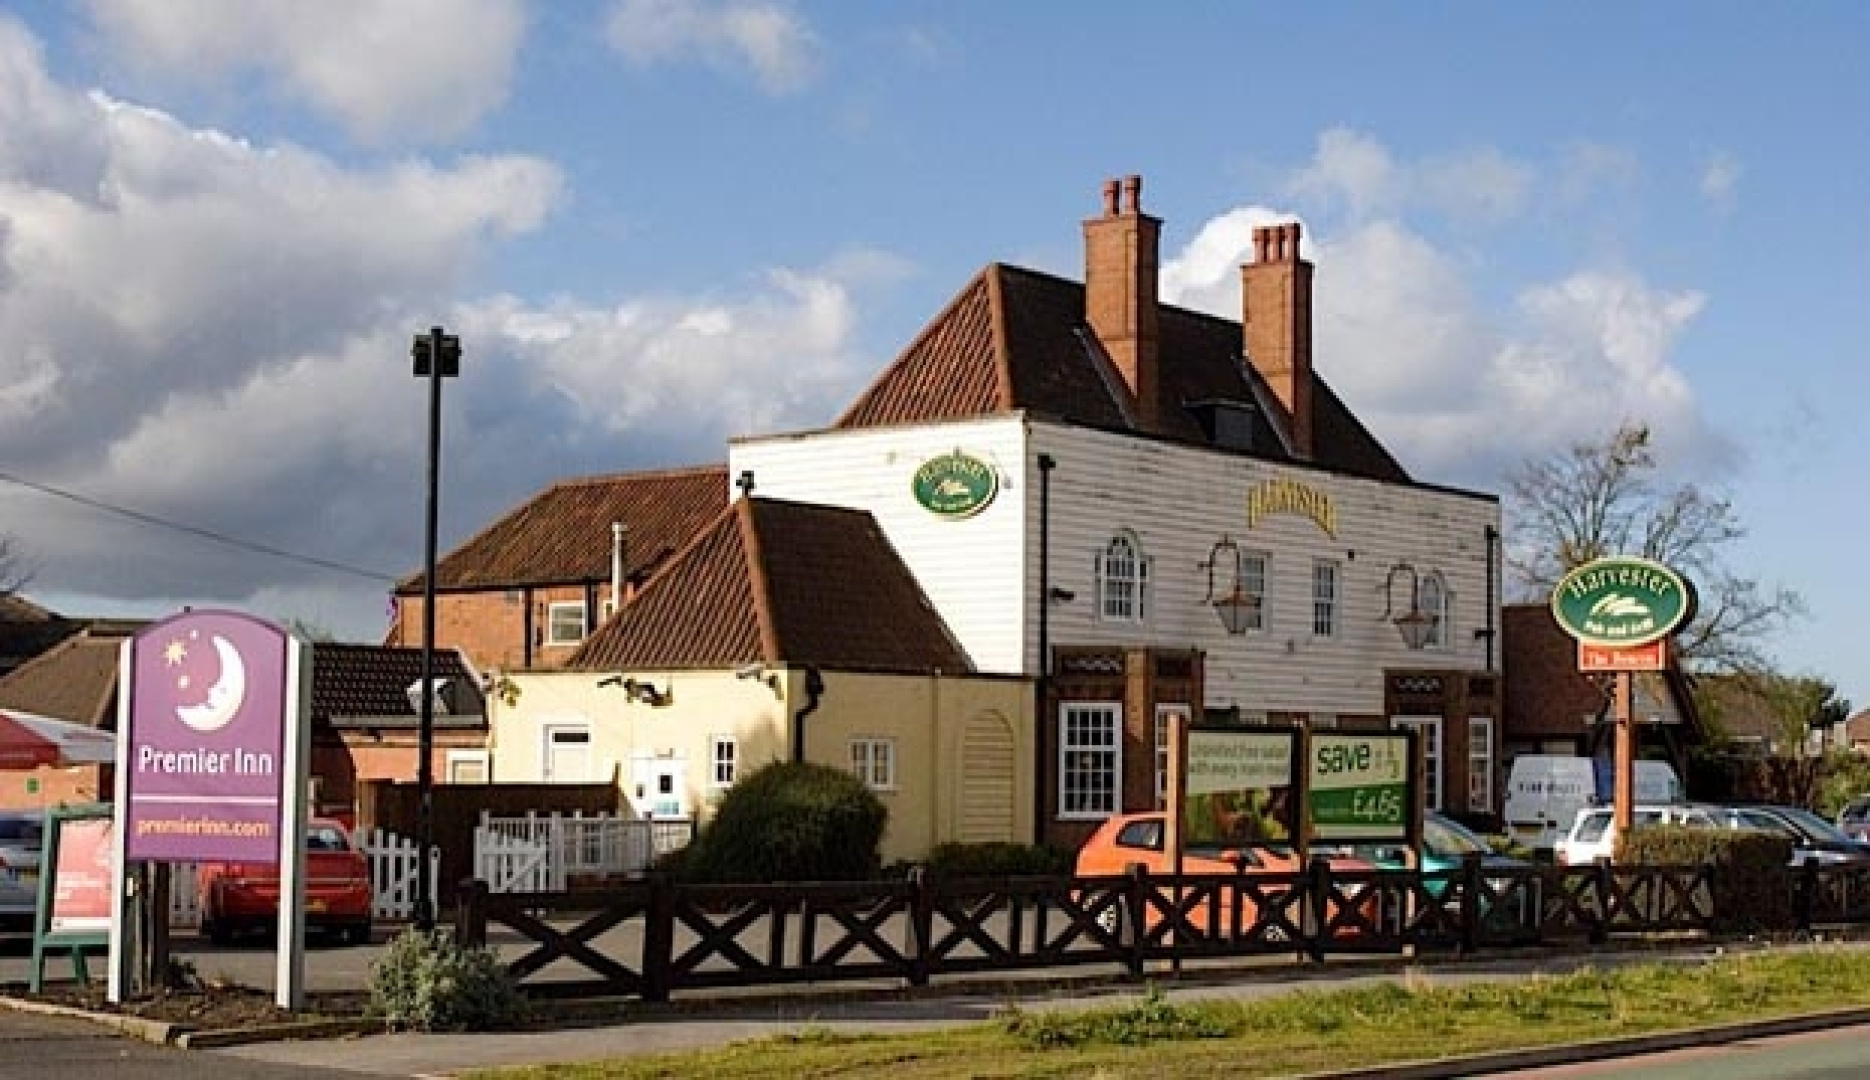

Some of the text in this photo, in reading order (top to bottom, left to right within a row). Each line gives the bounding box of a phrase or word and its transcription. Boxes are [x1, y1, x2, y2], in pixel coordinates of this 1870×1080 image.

[1568, 567, 1671, 599] Harvester
[138, 745, 272, 775] Premier Inn
[1317, 743, 1370, 775] save
[137, 815, 271, 838] premierinn.com
